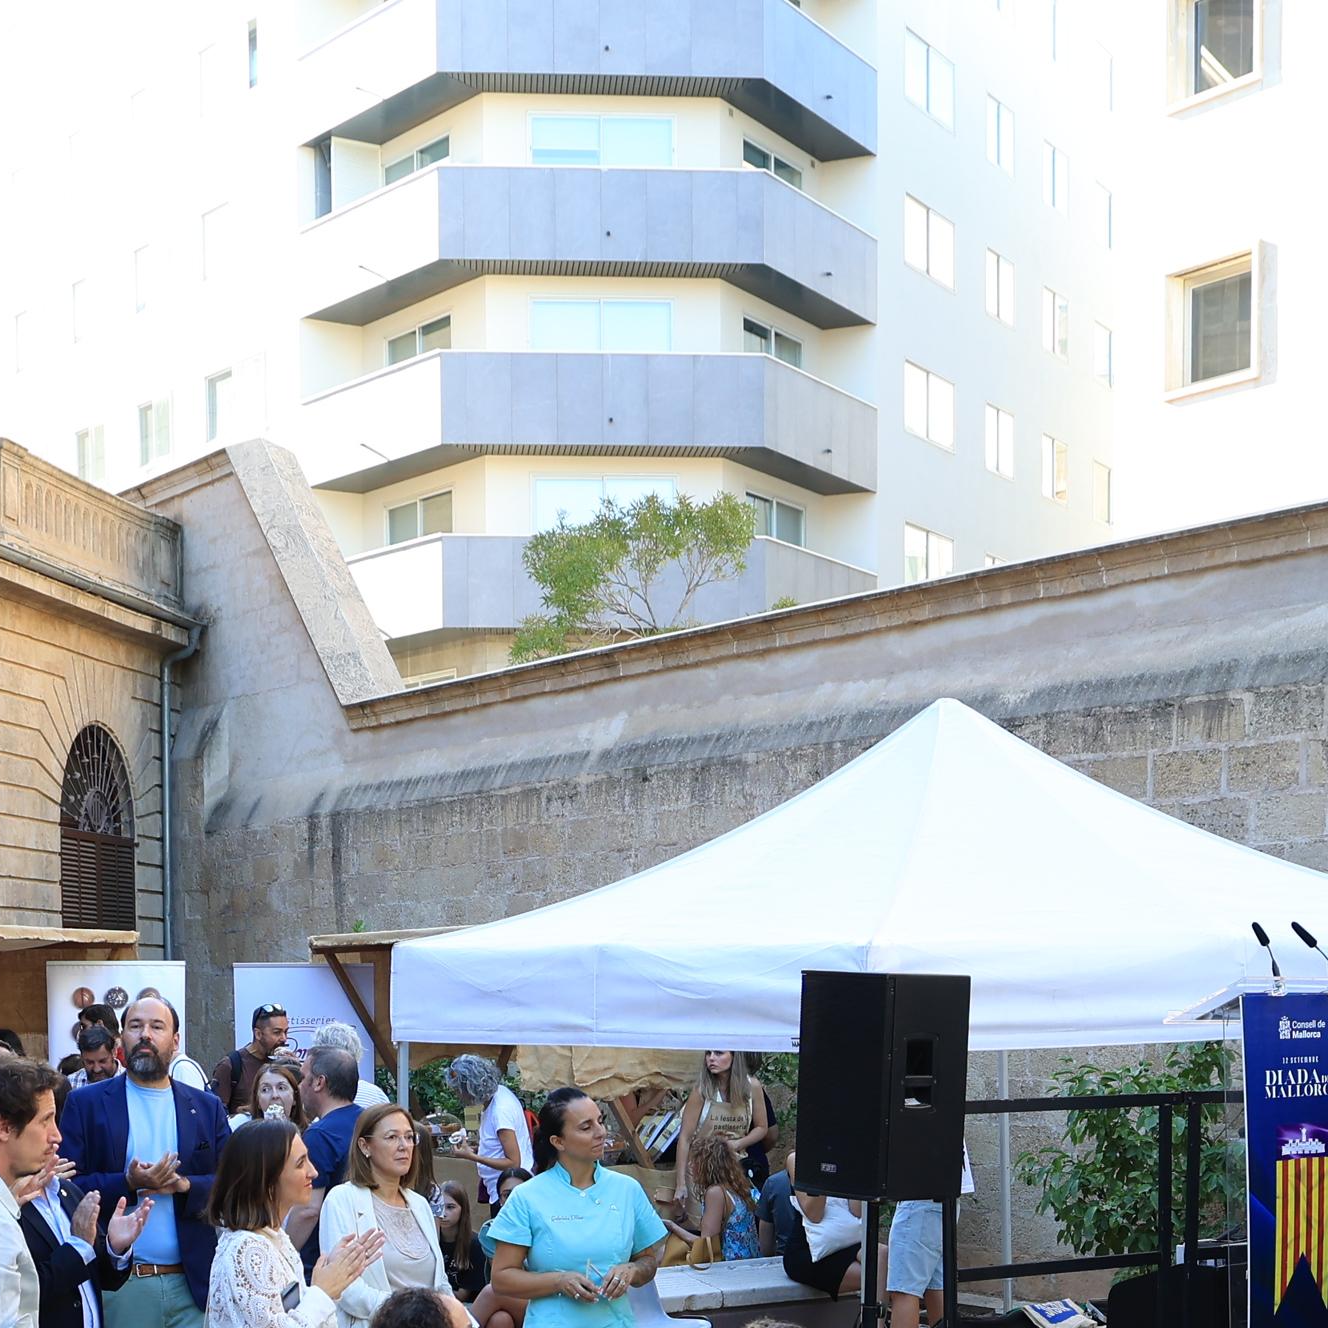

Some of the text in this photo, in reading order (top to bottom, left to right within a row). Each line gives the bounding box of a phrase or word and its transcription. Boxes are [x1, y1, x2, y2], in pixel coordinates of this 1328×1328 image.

[1292, 1019, 1326, 1029] Consell de
[1292, 1030, 1321, 1039] Mallorca
[1265, 1068, 1321, 1086] DIADA
